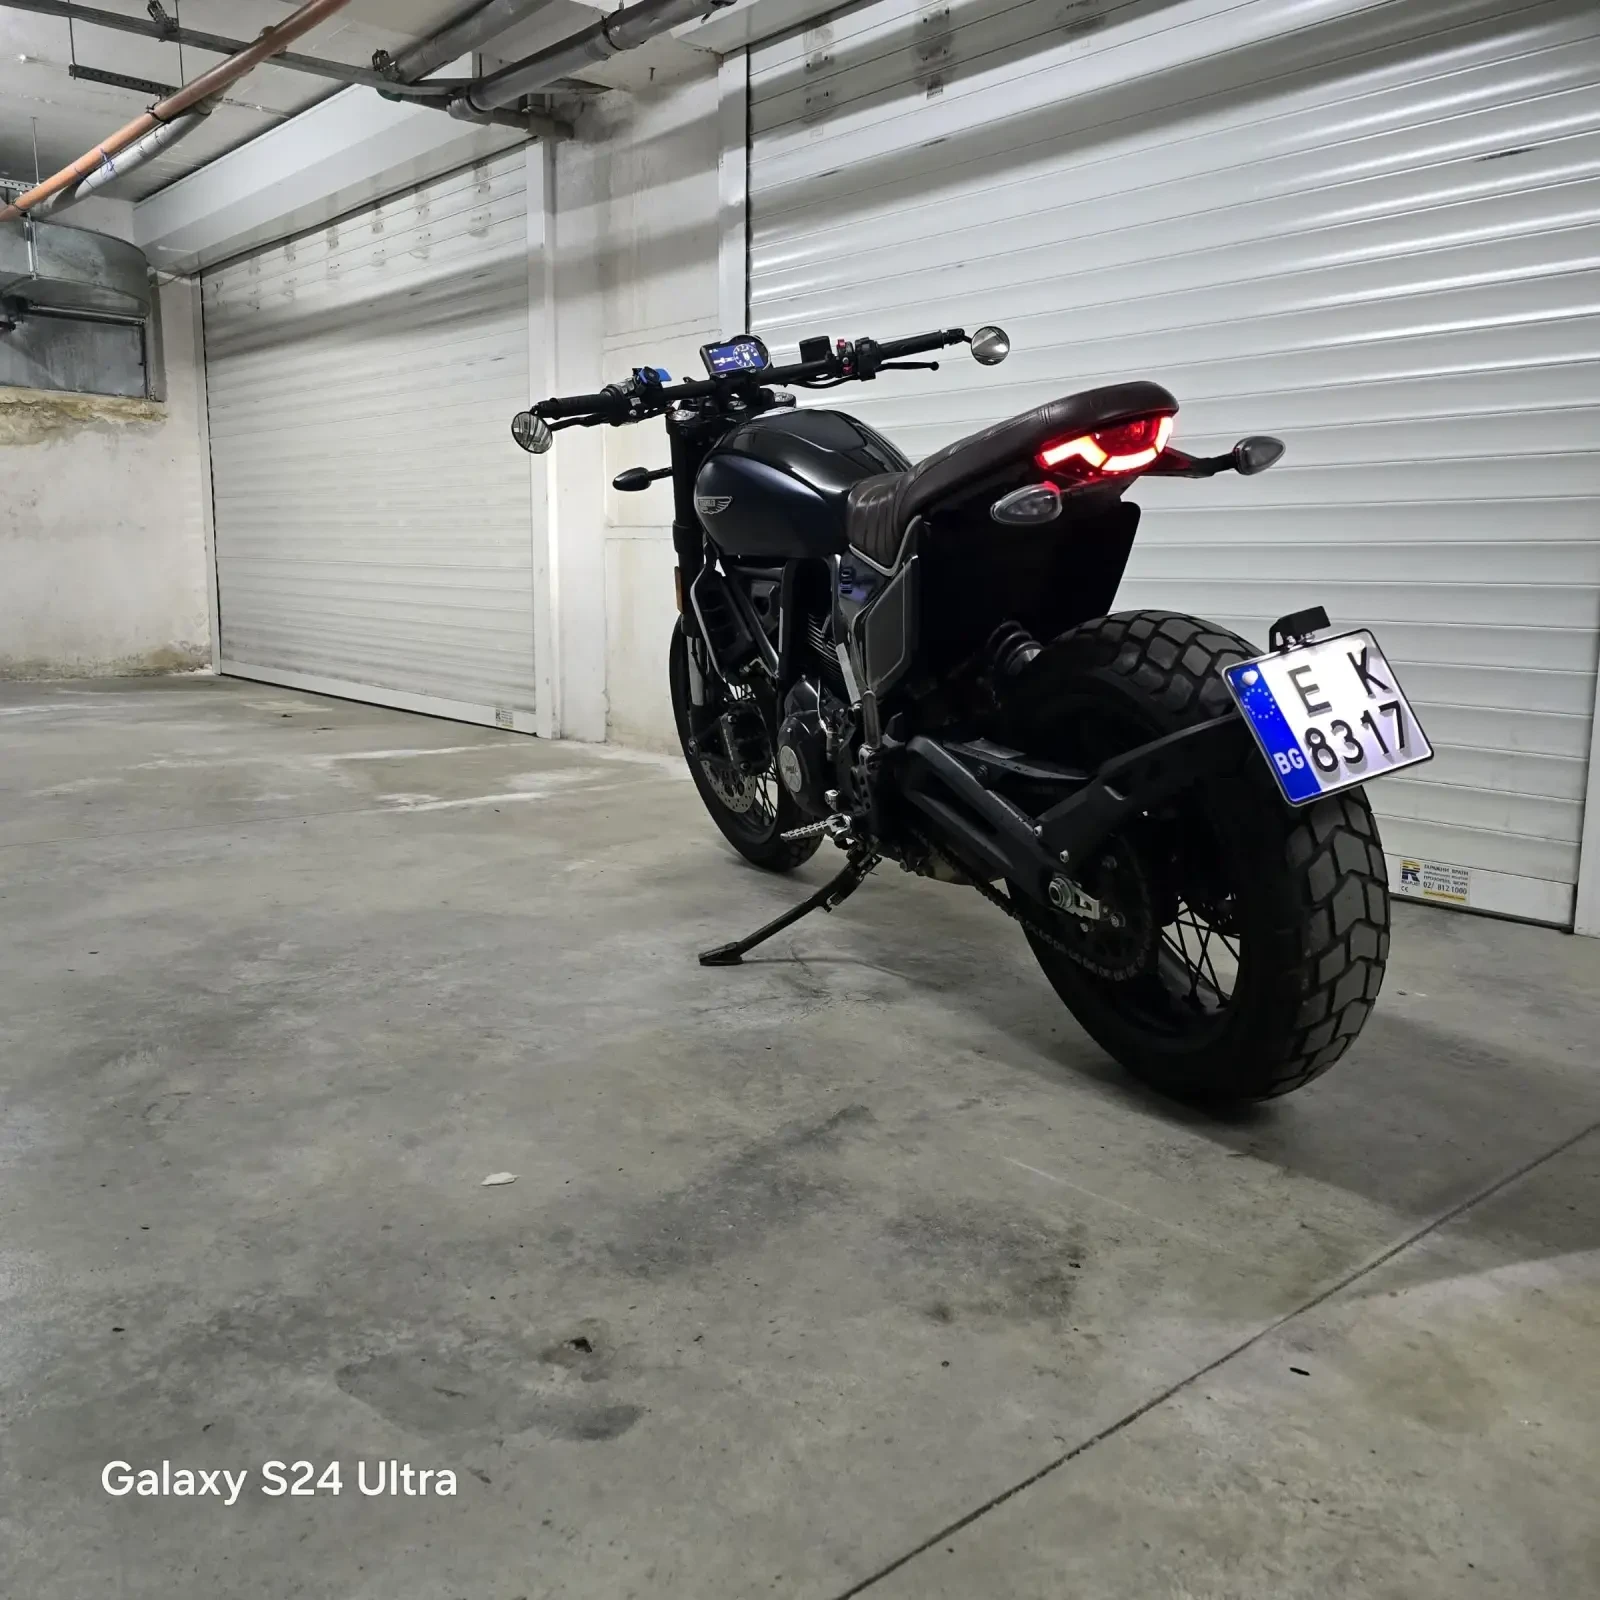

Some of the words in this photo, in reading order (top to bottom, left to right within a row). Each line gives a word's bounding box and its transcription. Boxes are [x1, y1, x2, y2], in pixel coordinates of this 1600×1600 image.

[1287, 664, 1333, 717] E
[1346, 646, 1393, 699] K
[1273, 748, 1305, 775] BG
[1304, 700, 1406, 773] 8317
